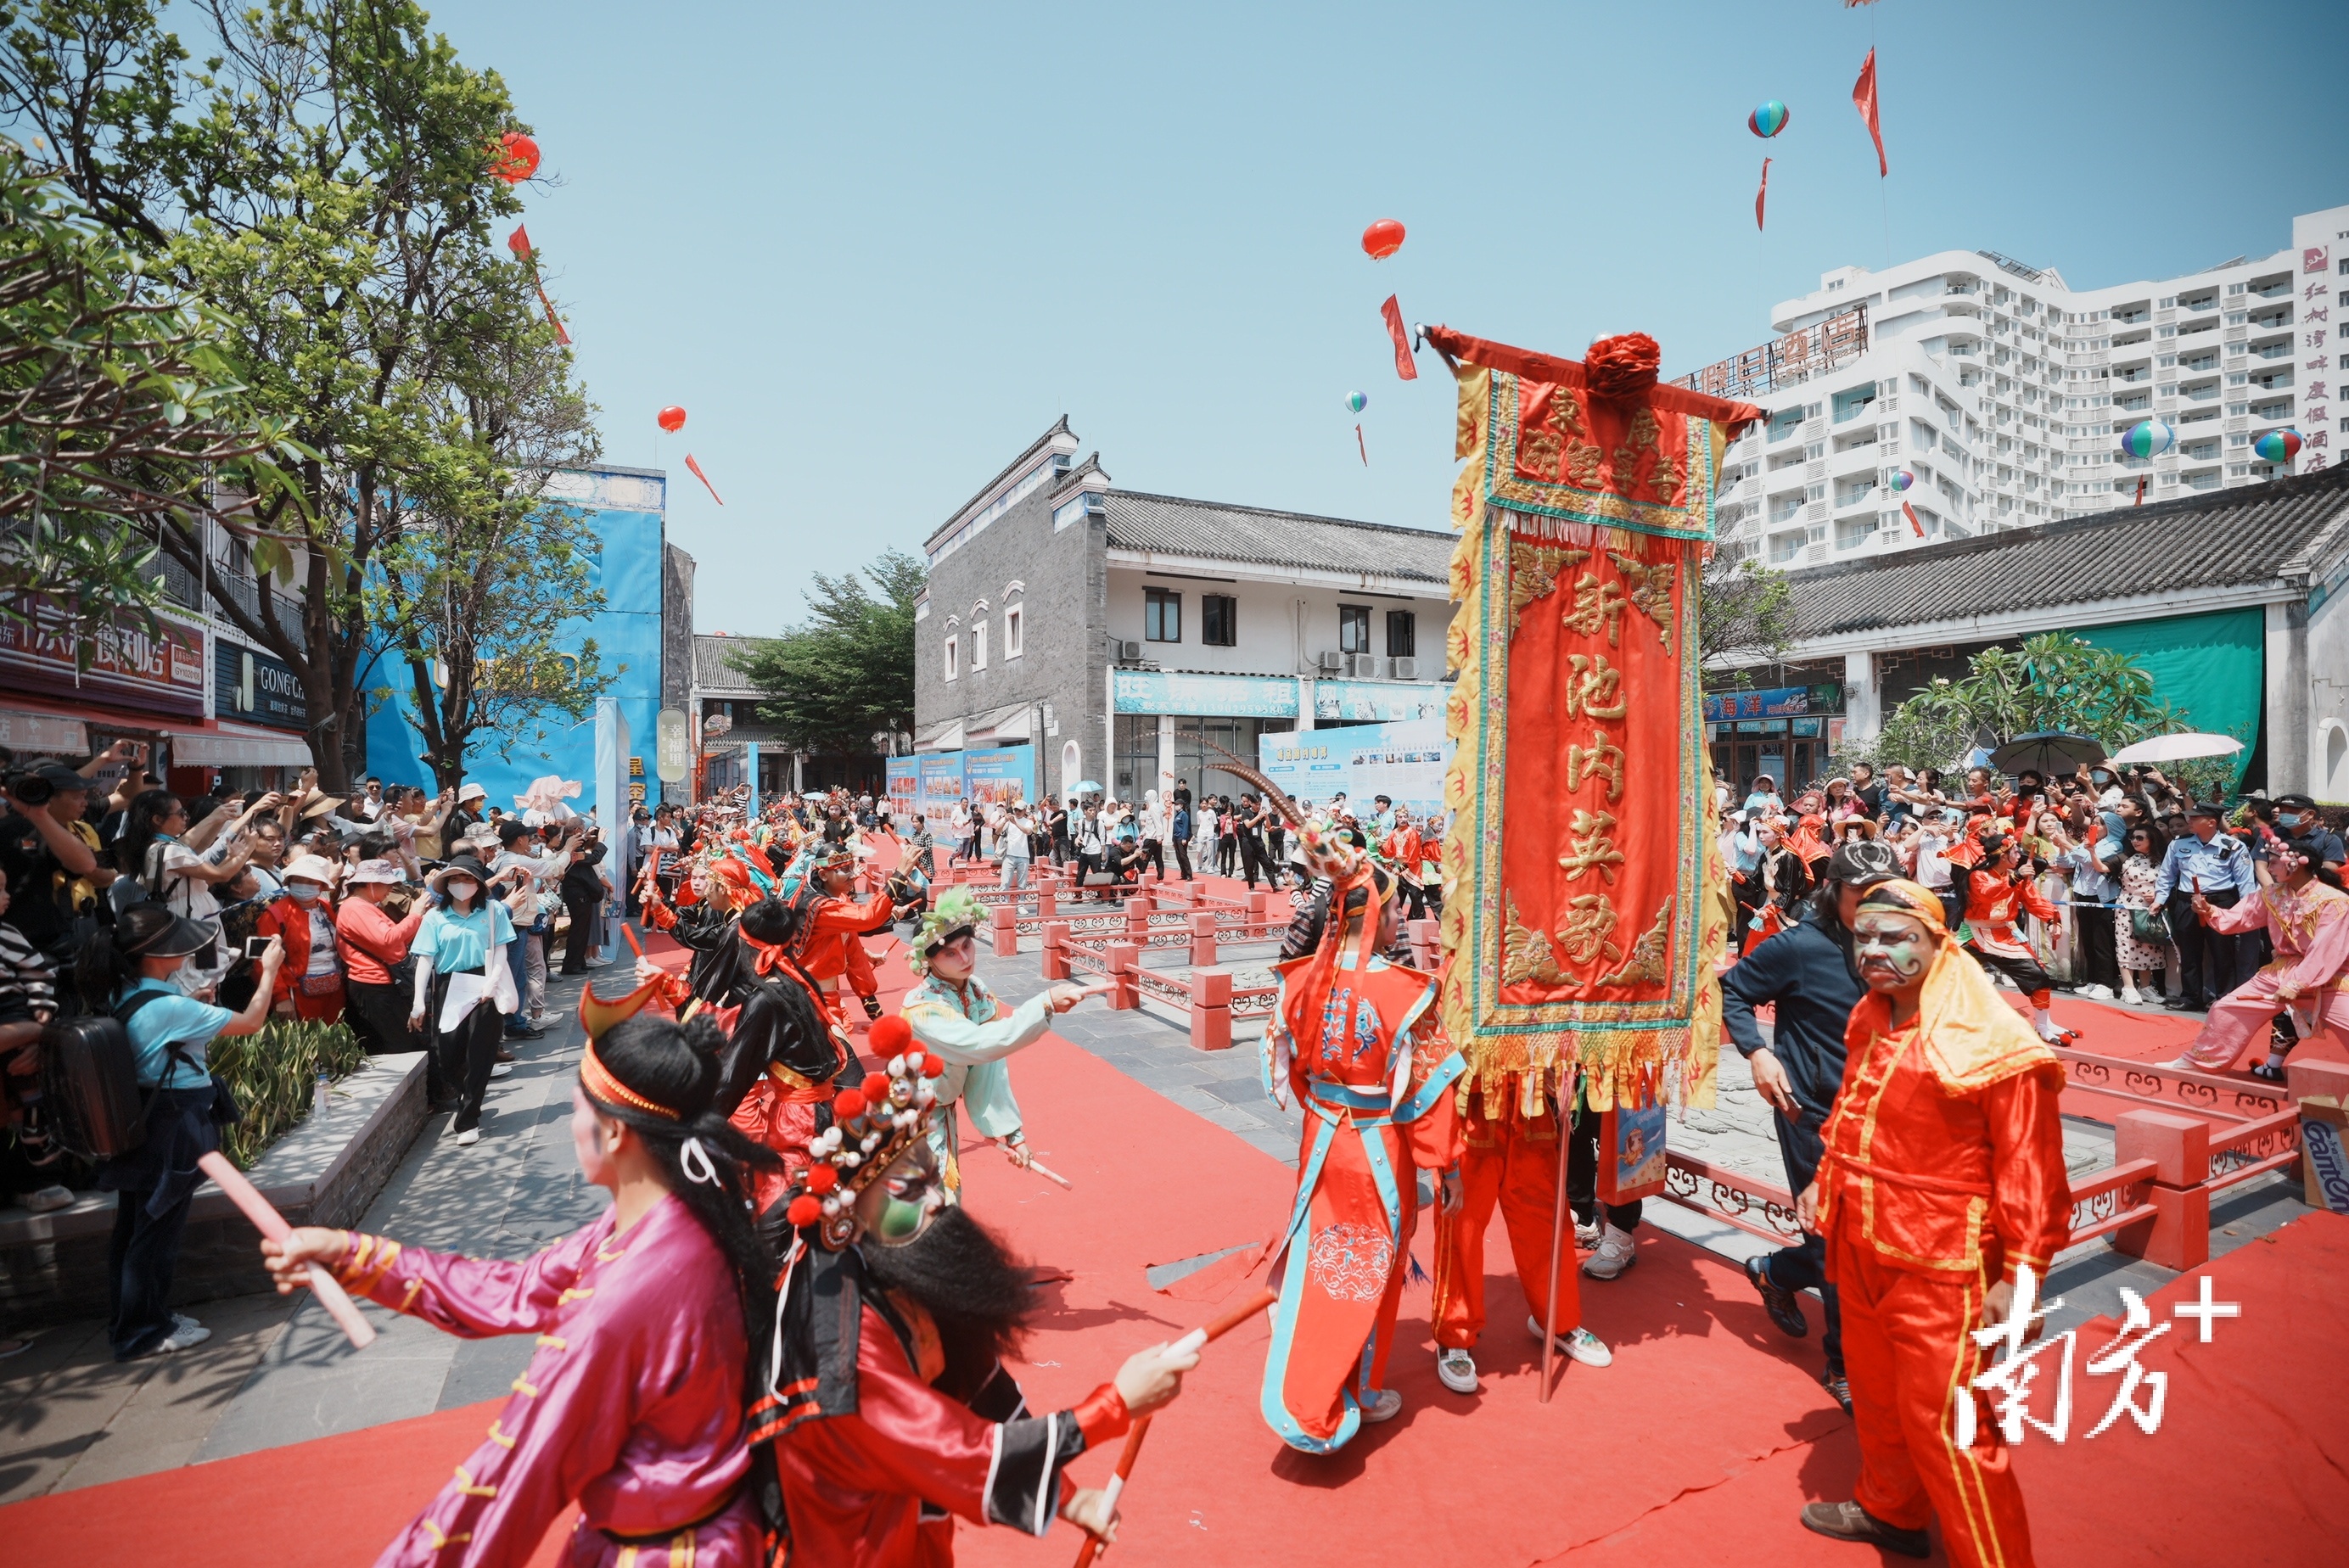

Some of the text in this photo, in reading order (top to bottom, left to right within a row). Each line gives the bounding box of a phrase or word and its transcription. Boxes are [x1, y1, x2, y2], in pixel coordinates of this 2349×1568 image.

[2303, 282, 2329, 473] 红树湾畔度假酒店
[261, 666, 290, 696] GONG
[1719, 693, 1763, 718] 海洋
[668, 723, 684, 767] 幸福里
